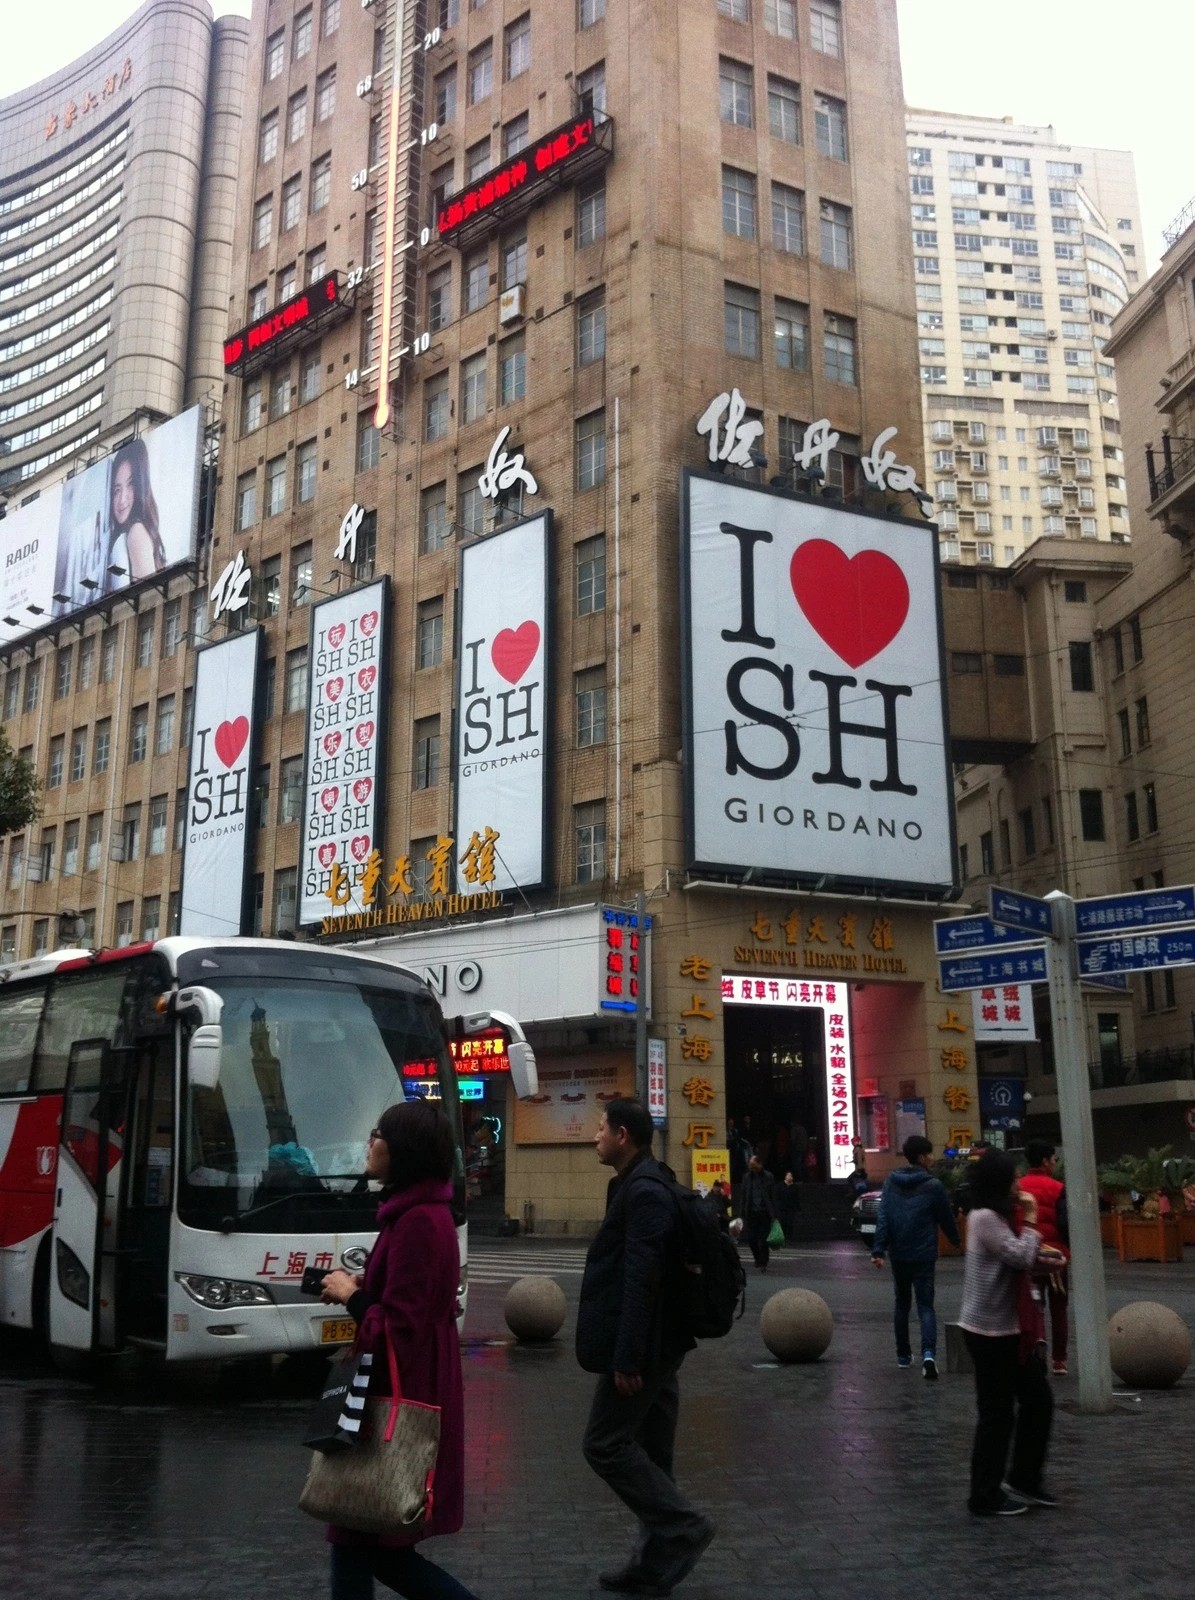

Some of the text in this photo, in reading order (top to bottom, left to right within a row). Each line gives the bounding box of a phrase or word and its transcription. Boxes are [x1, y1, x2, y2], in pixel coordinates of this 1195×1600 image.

[424, 27, 440, 50] 20
[356, 75, 372, 97] 68
[421, 123, 437, 145] 10
[351, 169, 367, 190] 50
[421, 227, 429, 245] 0
[347, 266, 362, 289] 32
[413, 332, 430, 355] 10
[345, 369, 358, 389] 14
[6, 539, 39, 568] RADO
[719, 522, 776, 650] I
[318, 629, 326, 655] I
[349, 617, 358, 643] I
[316, 647, 344, 678] SH
[347, 635, 376, 667] SH
[464, 638, 485, 698] I
[315, 683, 324, 708] I
[347, 671, 356, 697] I
[313, 702, 341, 732] SH
[345, 691, 374, 722] SH
[464, 681, 540, 757] SH
[344, 726, 354, 752] I
[725, 656, 918, 796] SH
[194, 727, 211, 777] I
[313, 736, 322, 761] I
[343, 746, 372, 777] SH
[310, 756, 339, 786] SH
[463, 748, 540, 778] GIORDANO
[191, 766, 246, 826] SH
[310, 791, 320, 817] I
[342, 782, 351, 808] I
[308, 811, 337, 842] SH
[340, 803, 370, 834] SH
[724, 798, 923, 841] GIORDANO
[190, 822, 245, 844] GIORDANO
[307, 846, 316, 872] I
[340, 839, 349, 865] I
[305, 869, 332, 897] SH
[322, 890, 500, 935] SEVENTH HEAVEN HOTEL
[734, 945, 907, 973] SEVENTH HEAVEN HOTEL
[1110, 936, 1193, 959] 中国邮政 250m
[786, 982, 836, 1004] 闪亮开幕
[829, 1013, 844, 1039] 皮装
[462, 1039, 504, 1057] 闪亮开幕
[680, 954, 716, 1149] 老上海餐厅
[831, 1073, 850, 1146] 全场2折起
[256, 1251, 335, 1276] 上海市
